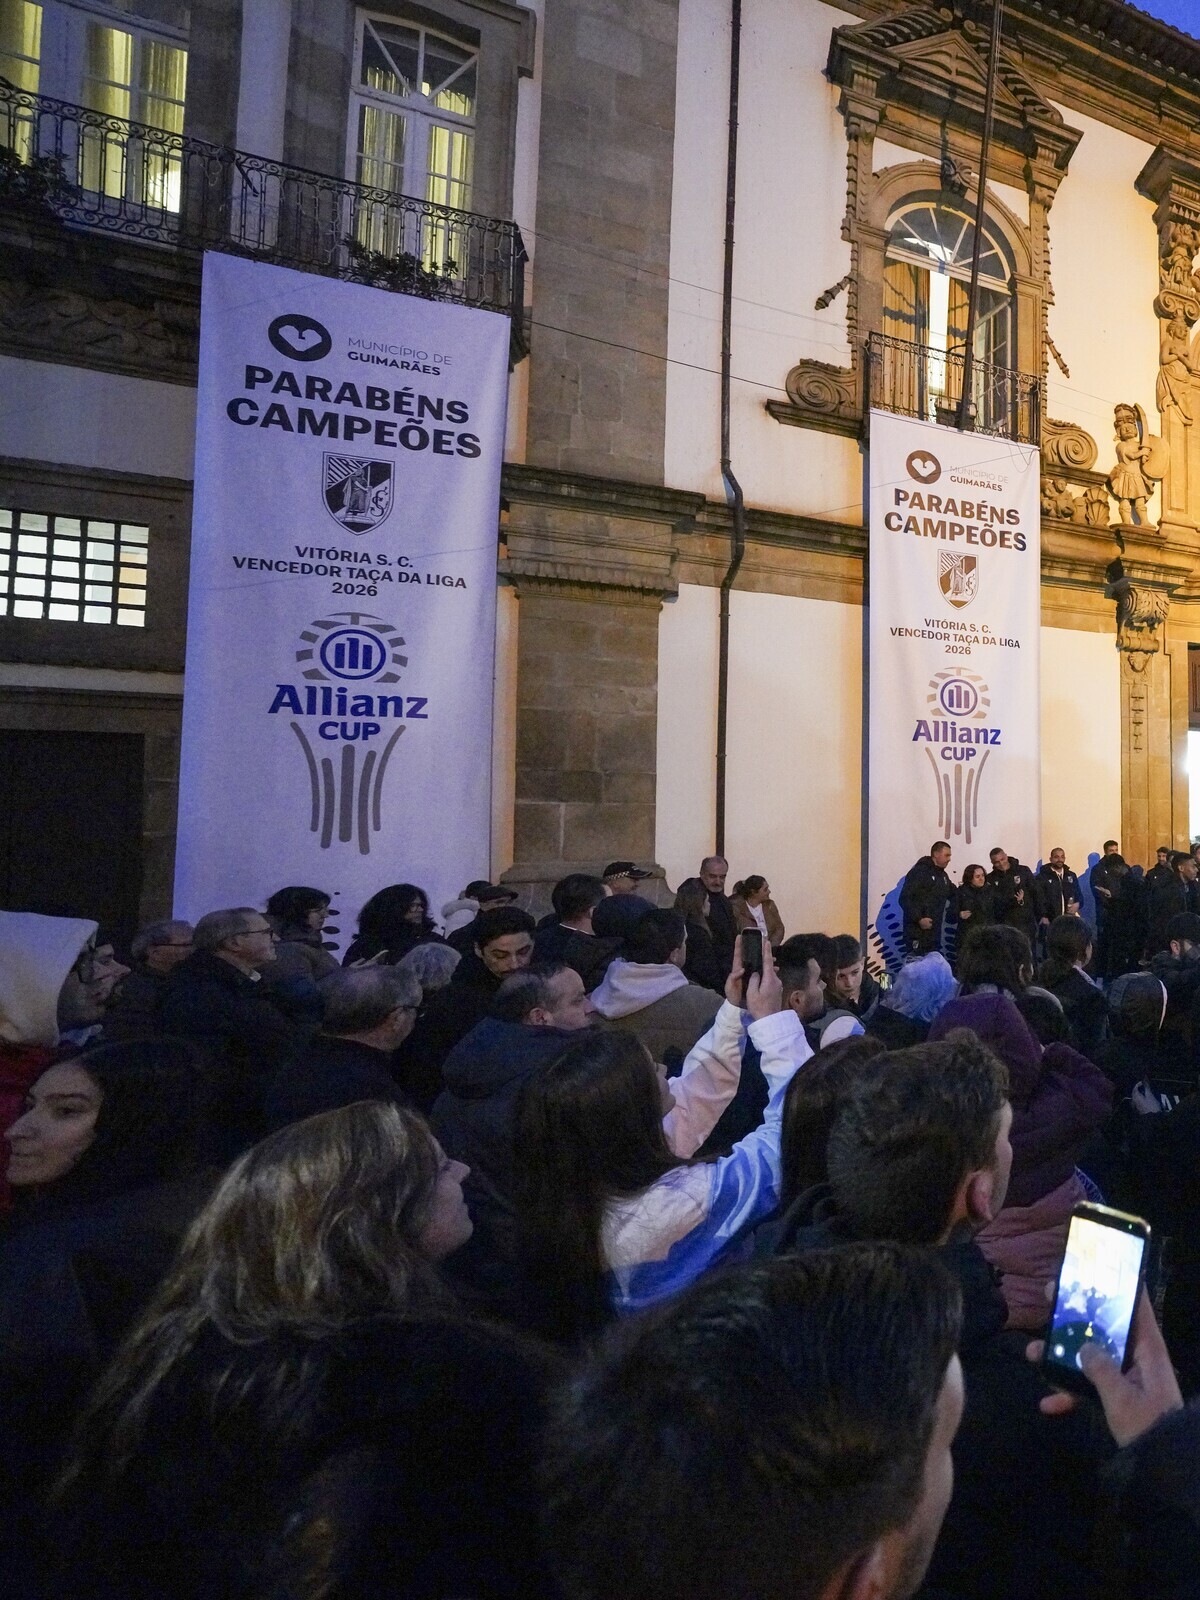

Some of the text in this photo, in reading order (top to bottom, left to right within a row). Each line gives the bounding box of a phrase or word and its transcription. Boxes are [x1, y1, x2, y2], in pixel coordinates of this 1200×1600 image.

[348, 337, 453, 366] MUNICÍPIO DE
[347, 351, 441, 376] GUIMARÃES
[245, 364, 470, 424] PARABÉNS
[226, 397, 482, 459] CAMPEÕES
[950, 475, 1003, 492] GUIMARÃES
[998, 474, 1009, 483] DE
[894, 488, 1020, 526] PARABÉNS
[884, 511, 1027, 552] CAMPEÕES
[295, 545, 372, 565] VITÓRIA
[232, 556, 467, 589] VENCEDOR TAÇA DA LIGA
[331, 582, 378, 597] 2026
[924, 618, 967, 631] VITÓRIA
[890, 627, 1021, 649] VENCEDOR TAÇA DA LIGA
[945, 645, 971, 655] 2026
[267, 684, 429, 719] Allianz
[318, 720, 381, 741] CUP
[912, 719, 1002, 746] Allianz
[940, 746, 977, 761] CUP
